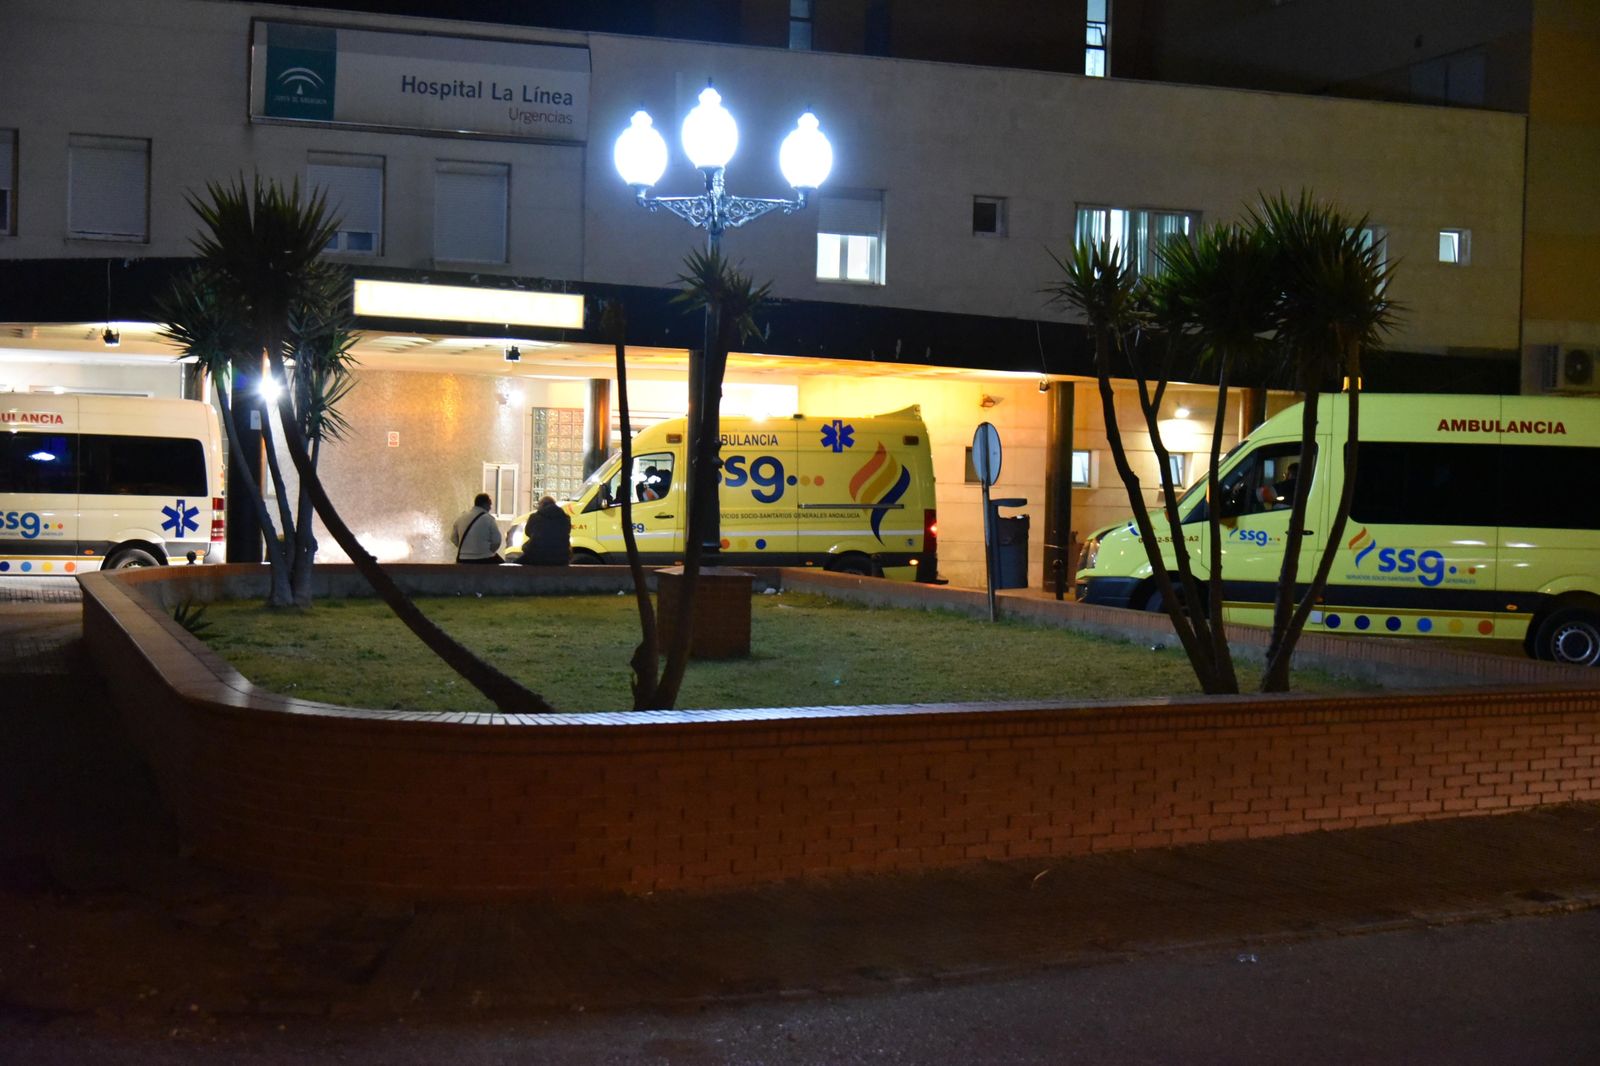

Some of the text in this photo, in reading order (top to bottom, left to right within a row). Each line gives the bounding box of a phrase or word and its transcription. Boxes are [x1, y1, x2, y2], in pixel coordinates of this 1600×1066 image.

[401, 75, 573, 106] Hospital La Línea
[508, 107, 573, 125] Urgencias
[0, 412, 64, 424] ULANCIA
[1437, 418, 1567, 435] AMBULANCIA
[720, 434, 779, 446] BULANCIA
[717, 456, 784, 503] sg
